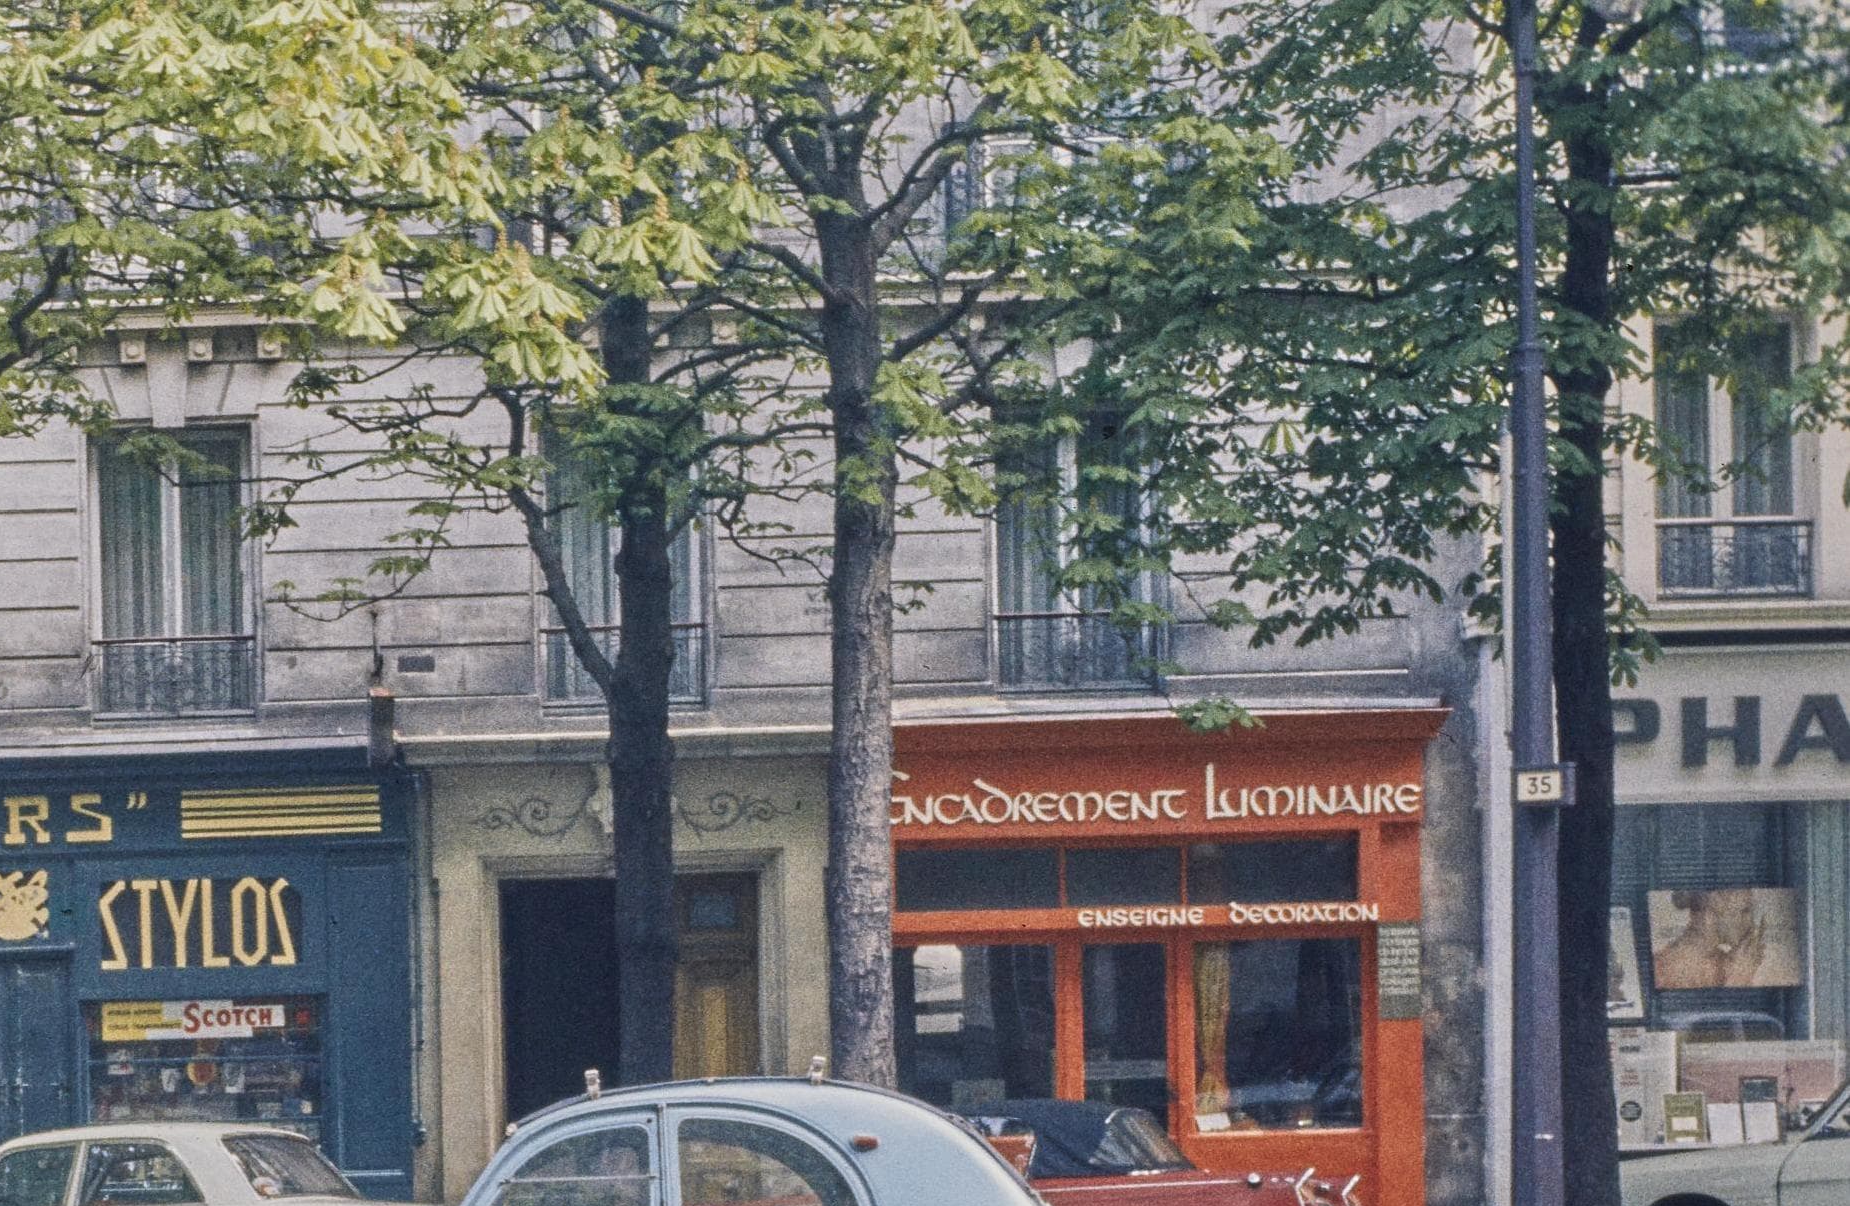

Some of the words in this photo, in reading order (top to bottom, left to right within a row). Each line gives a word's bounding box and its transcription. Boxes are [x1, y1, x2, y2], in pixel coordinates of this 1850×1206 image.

[1206, 762, 1422, 820] LUMINAIRE
[1527, 776, 1551, 795] 35
[99, 877, 296, 969] STYLOS
[1077, 906, 1204, 927] ENSEIGNE
[1229, 901, 1379, 924] DECORATION
[183, 1003, 273, 1034] SCOTCH
